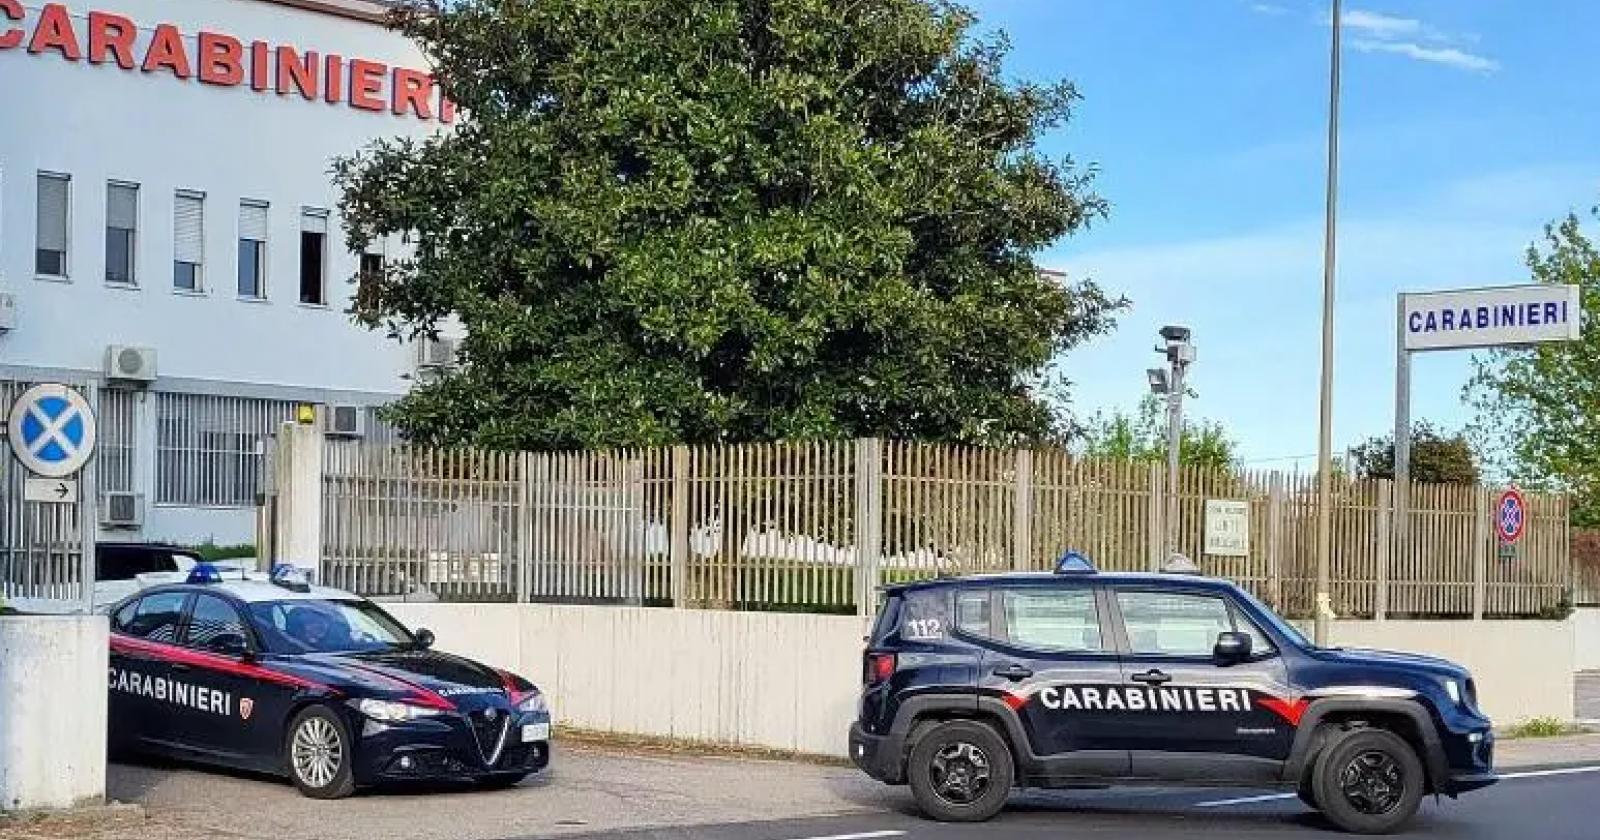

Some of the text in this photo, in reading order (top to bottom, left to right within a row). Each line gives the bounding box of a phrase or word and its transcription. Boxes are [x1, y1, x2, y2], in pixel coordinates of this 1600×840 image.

[1408, 301, 1568, 333] CARABINIERI
[907, 618, 942, 639] 112
[1040, 687, 1252, 712] CARABINIERI
